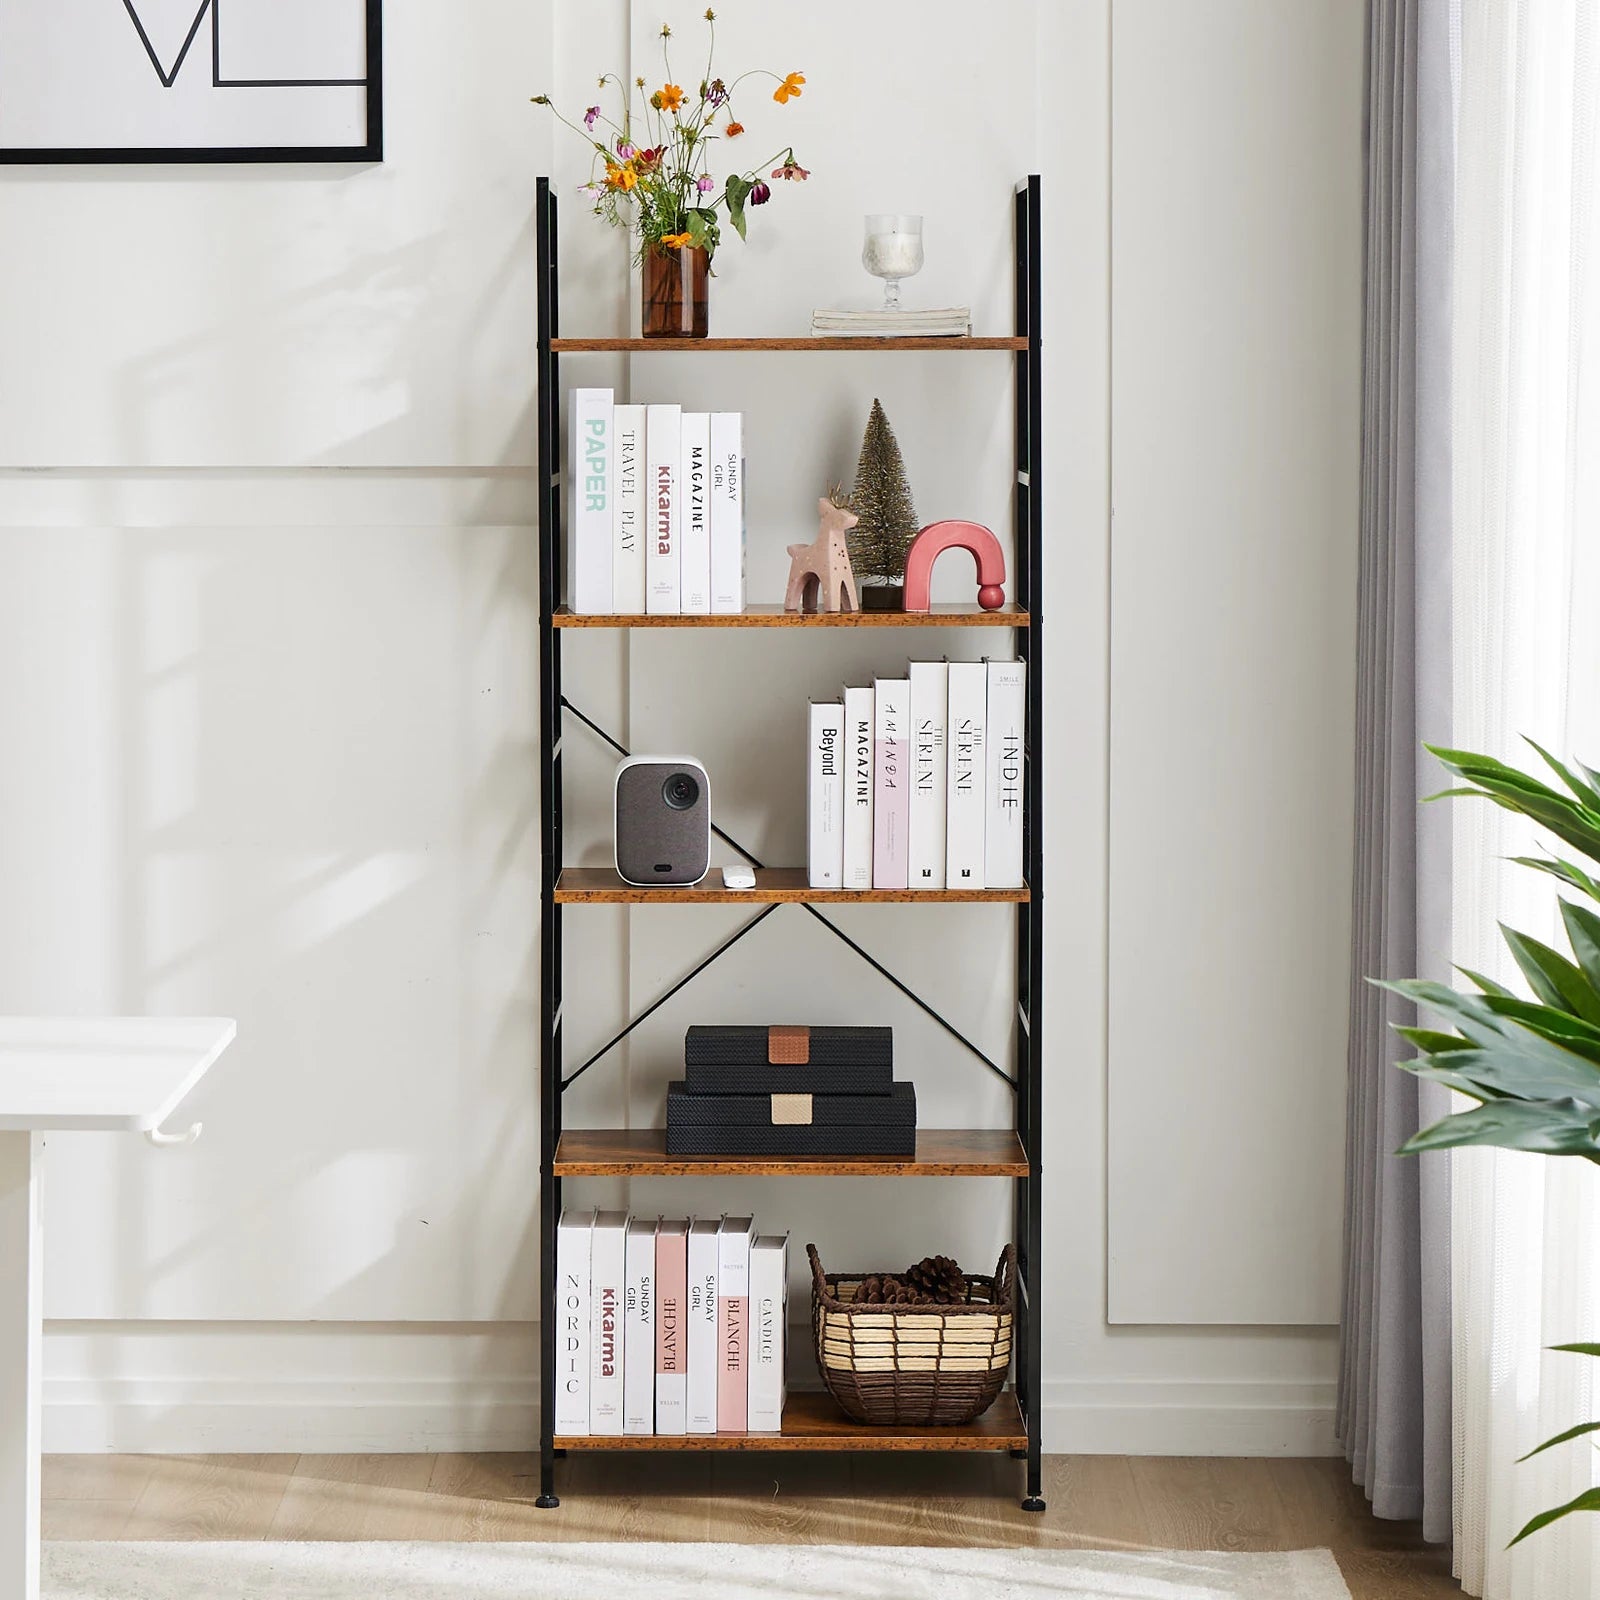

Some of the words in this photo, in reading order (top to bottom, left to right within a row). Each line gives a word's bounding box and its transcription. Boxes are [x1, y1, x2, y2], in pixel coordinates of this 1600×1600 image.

[585, 419, 607, 512] PAPER
[622, 430, 635, 498] TRAVEL
[691, 447, 703, 532] MAGAZINE
[714, 465, 723, 490] GIRL
[727, 454, 737, 502] SUNDAY
[621, 511, 635, 553] PLAY
[658, 465, 675, 555] kikarma
[818, 728, 837, 776] Beyond
[857, 721, 869, 807] MAGAZINE
[885, 704, 897, 789] AMANDA
[918, 719, 934, 797] SERENE
[957, 719, 973, 797] SERENE
[1002, 736, 1019, 809] INDIE
[566, 1274, 580, 1395] NORDIC
[602, 1288, 619, 1378] kikarma
[627, 1287, 636, 1313] GIRL
[640, 1276, 650, 1324] SUNDAY
[663, 1298, 676, 1371] BLANCHE
[691, 1286, 701, 1311] GIRL
[705, 1275, 715, 1323] SUNDAY
[761, 1298, 773, 1364] CANDICE
[727, 1299, 740, 1372] BLANCHE
